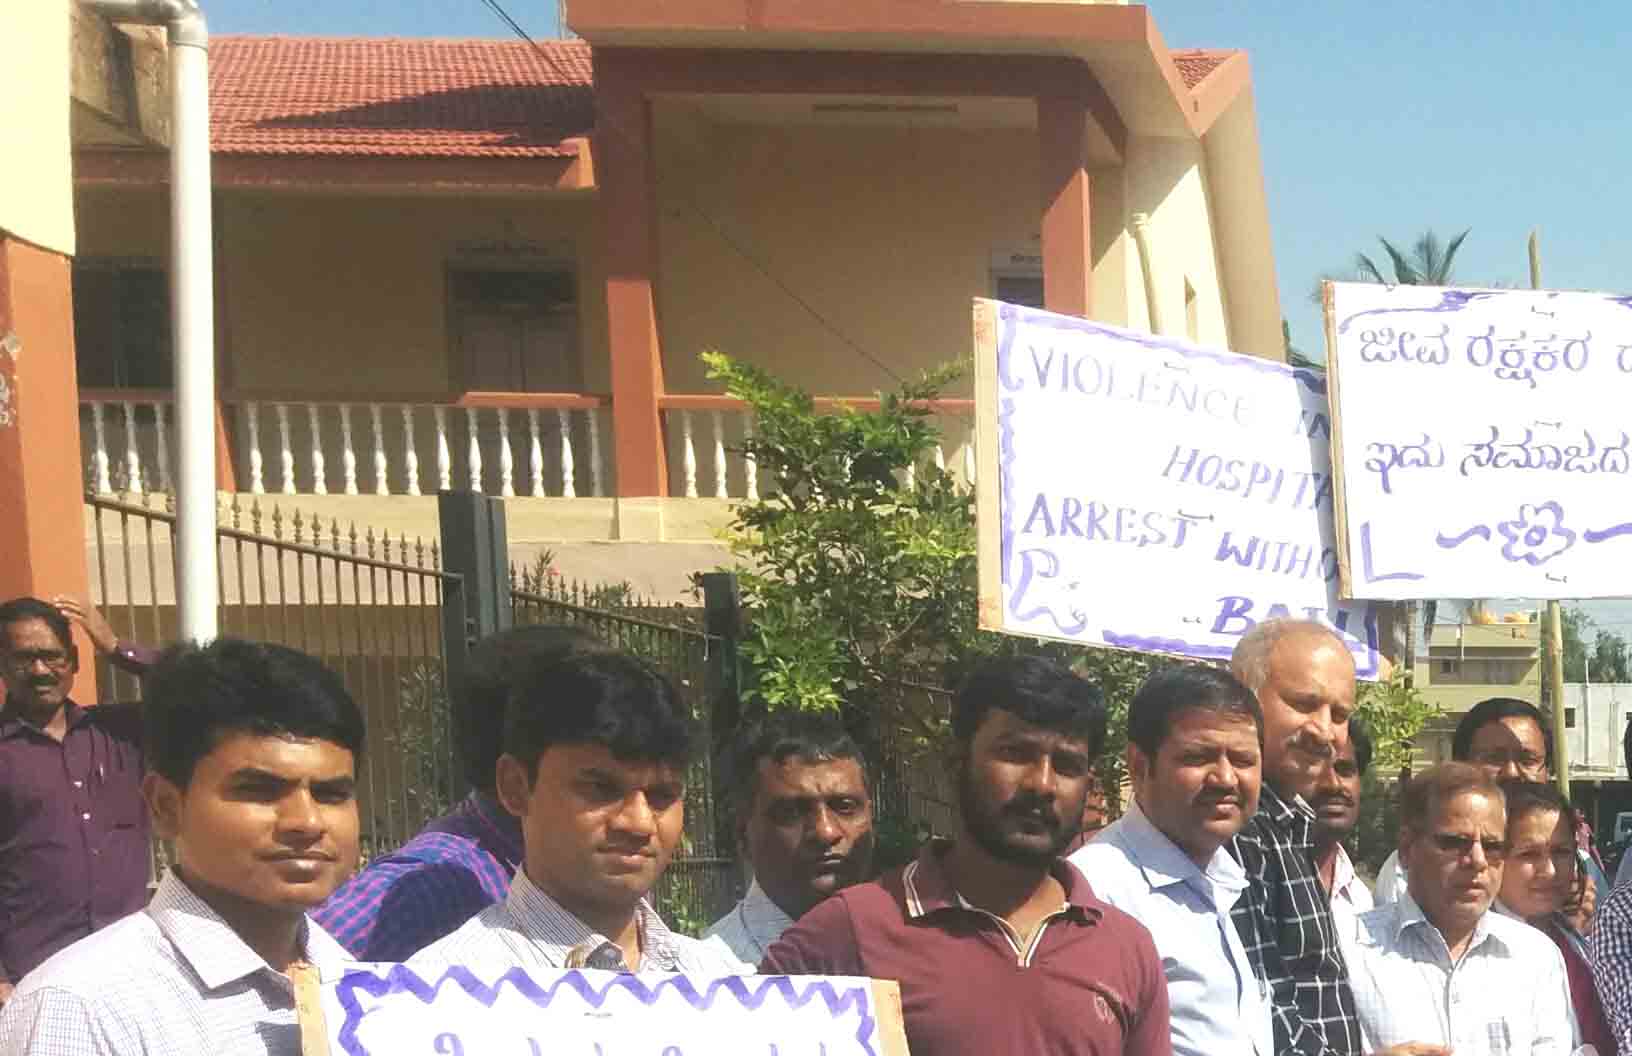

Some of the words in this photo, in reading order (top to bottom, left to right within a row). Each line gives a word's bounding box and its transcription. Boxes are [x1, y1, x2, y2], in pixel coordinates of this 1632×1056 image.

[1028, 346, 1251, 426] VIOLENCE
[1358, 323, 1451, 365] ಜೀವ
[1466, 325, 1593, 389] ರಕ್ಷಕರ
[1162, 445, 1332, 511] HOSPITA
[1364, 432, 1445, 494] ಇದು
[1459, 425, 1631, 477] ಸಮಾಜದ
[1213, 531, 1340, 583] WITHO
